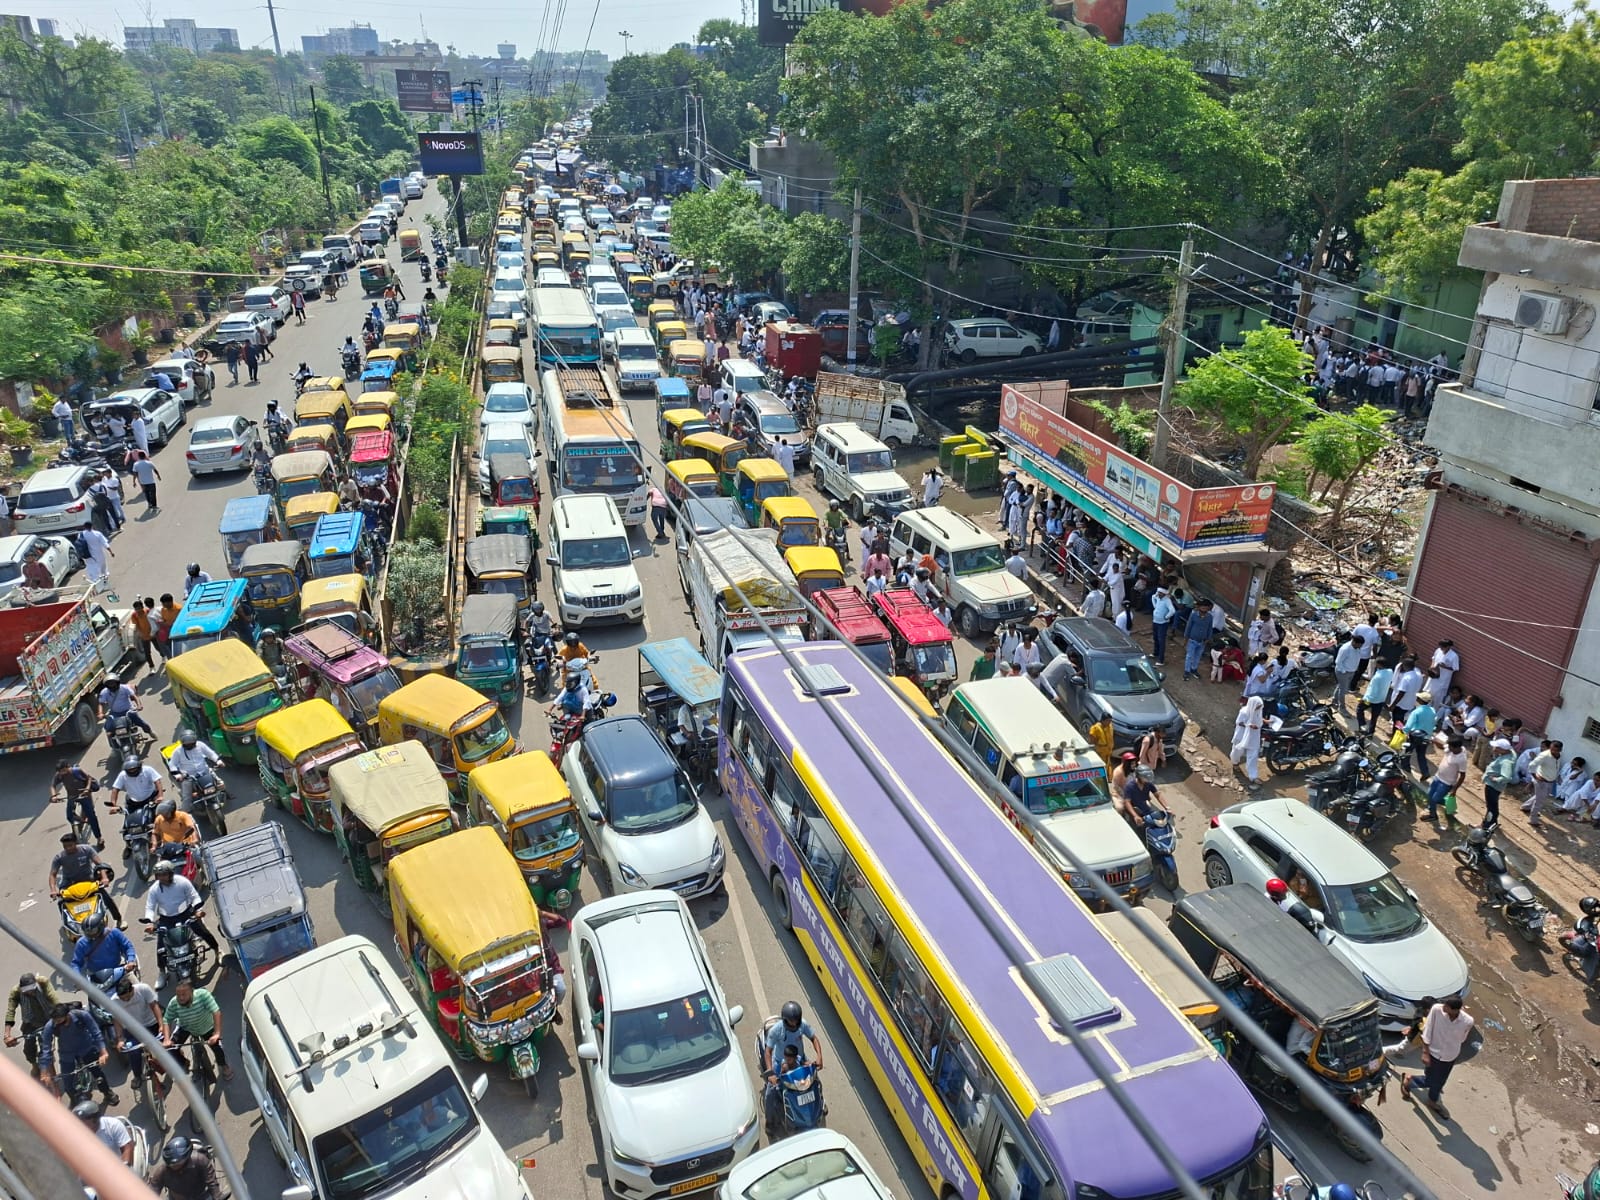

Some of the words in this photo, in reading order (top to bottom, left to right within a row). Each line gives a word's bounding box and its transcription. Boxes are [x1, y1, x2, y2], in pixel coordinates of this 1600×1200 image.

[431, 140, 466, 150] NovoDS
[1018, 411, 1043, 447] बिहार
[1198, 500, 1224, 513] बिहार
[819, 924, 846, 977] राज्य
[847, 973, 867, 1017] पथ
[868, 1009, 920, 1108] परिवहन
[922, 1102, 968, 1193] निगम
